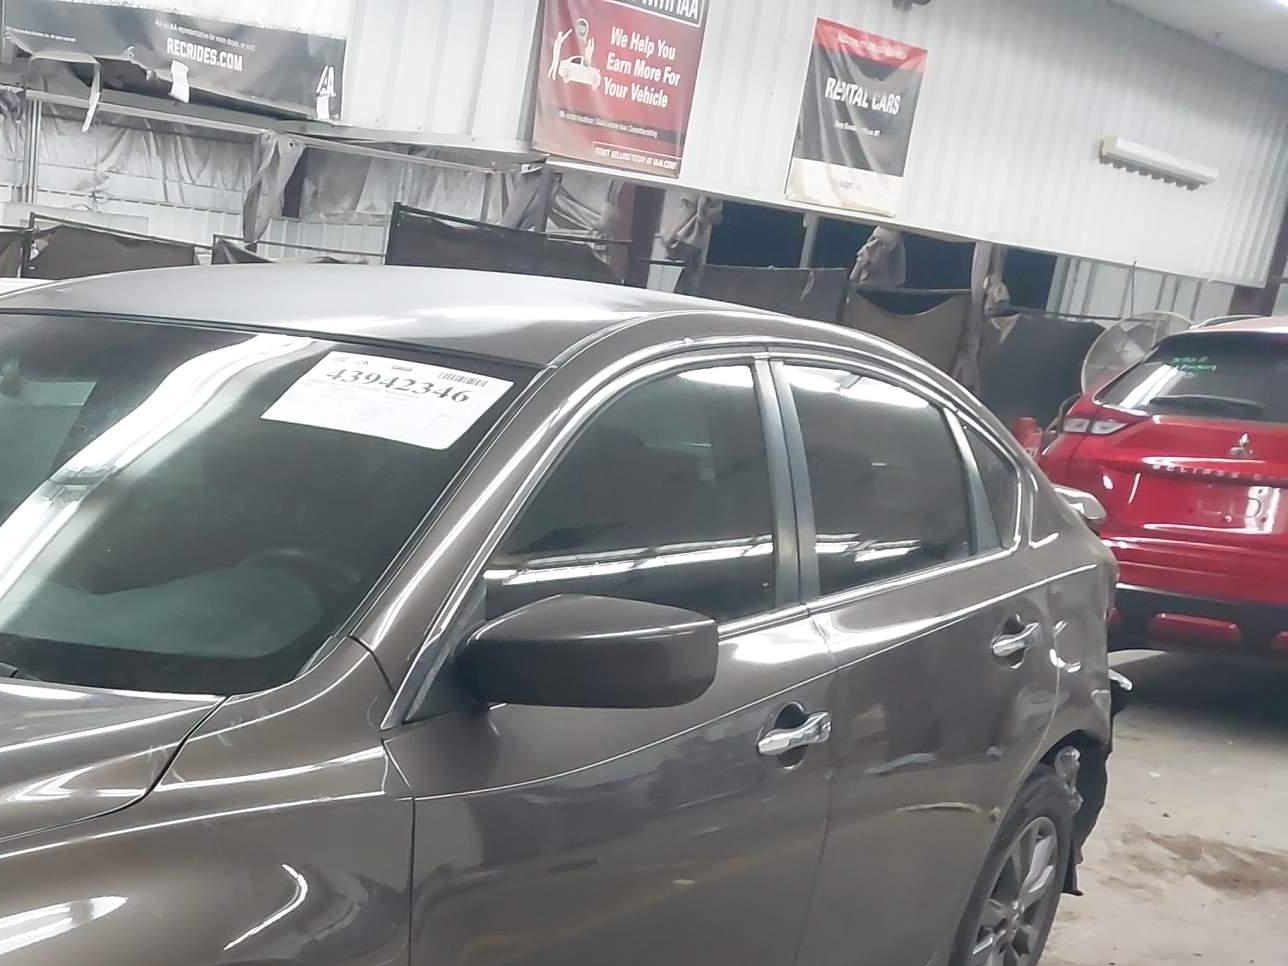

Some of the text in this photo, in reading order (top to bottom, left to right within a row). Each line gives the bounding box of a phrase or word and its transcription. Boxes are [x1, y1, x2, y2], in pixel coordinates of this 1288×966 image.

[167, 37, 243, 72] RECRIDES.COM
[611, 26, 676, 60] We Help You
[606, 52, 681, 86] Earn More For
[604, 76, 669, 108] Your Vehicle
[824, 77, 901, 115] RENTAL CARS
[326, 368, 472, 403] 43942346
